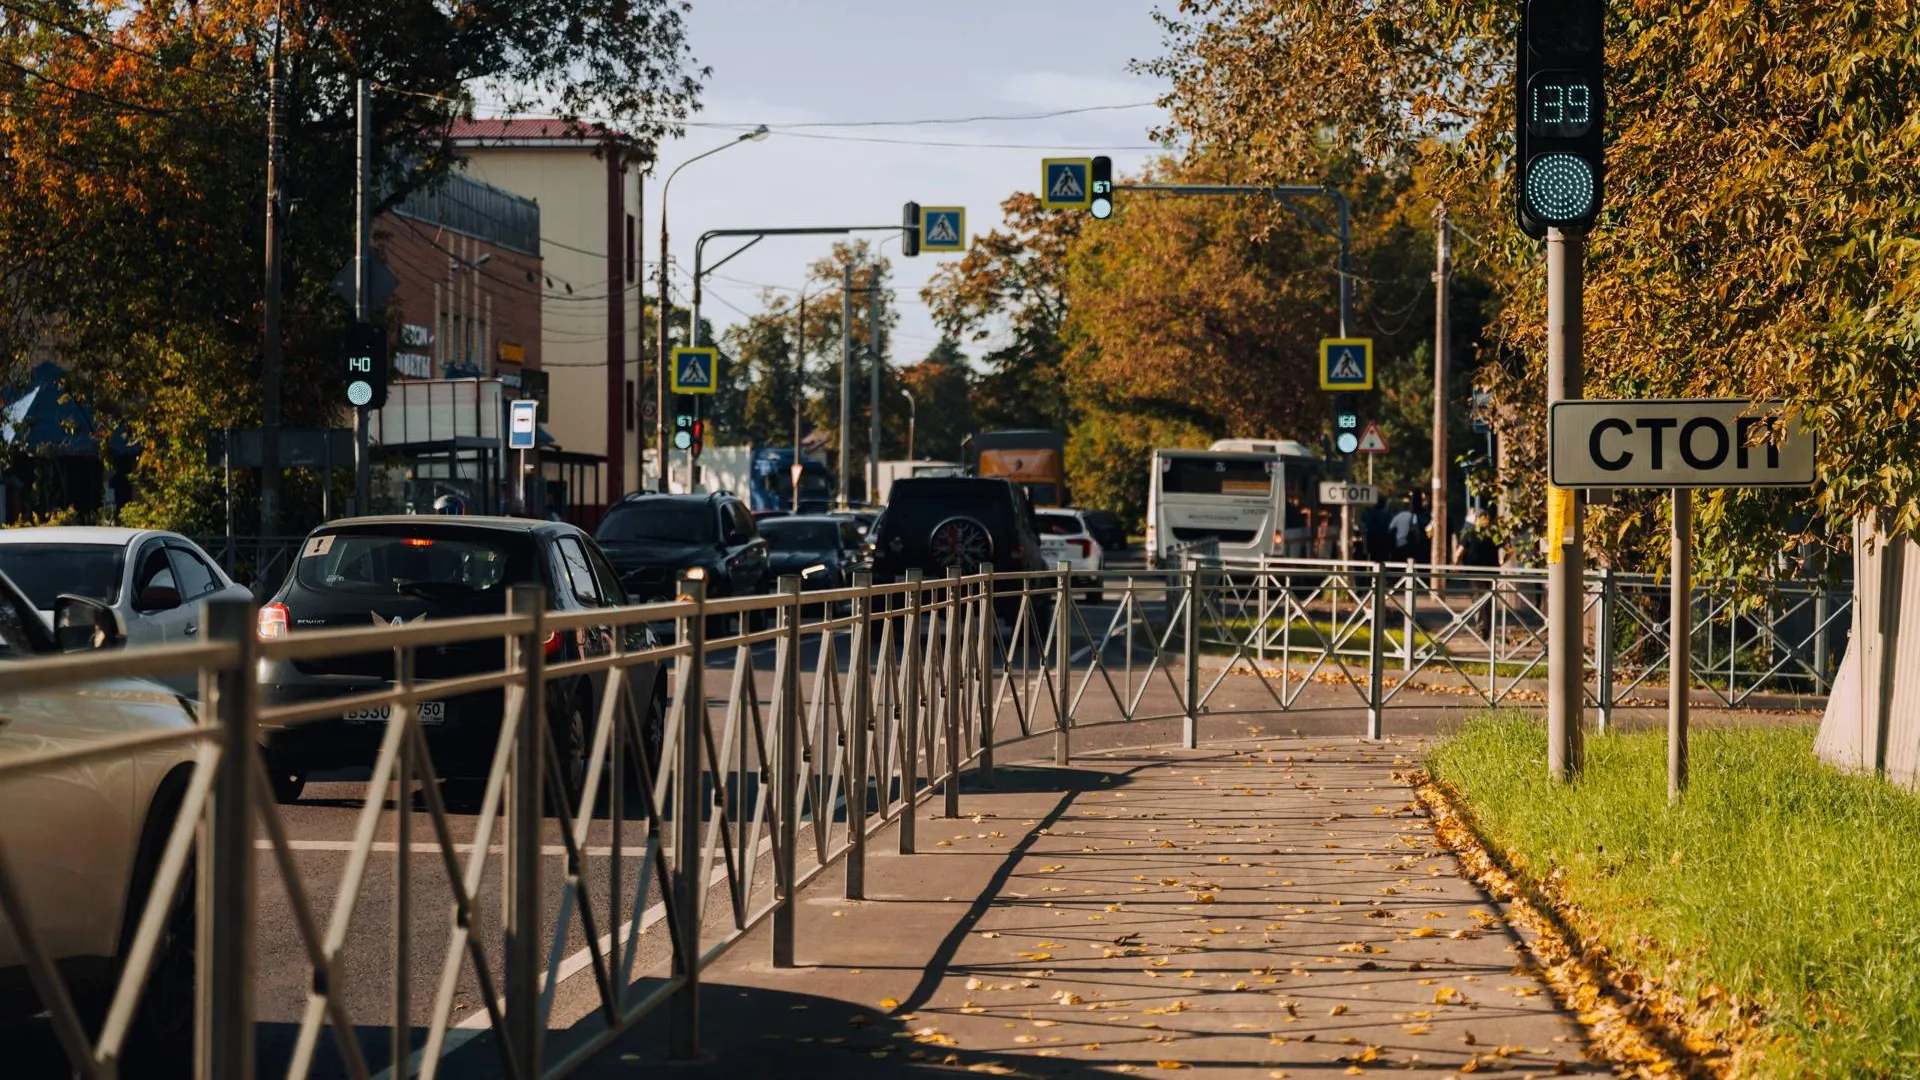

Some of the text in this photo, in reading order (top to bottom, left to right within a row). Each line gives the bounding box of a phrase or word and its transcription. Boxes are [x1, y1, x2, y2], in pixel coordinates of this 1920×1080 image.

[1533, 84, 1590, 124] 139
[349, 356, 371, 372] 140
[1588, 416, 1780, 471] СТОП
[1329, 486, 1371, 502] СТОП
[415, 702, 441, 716] 750
